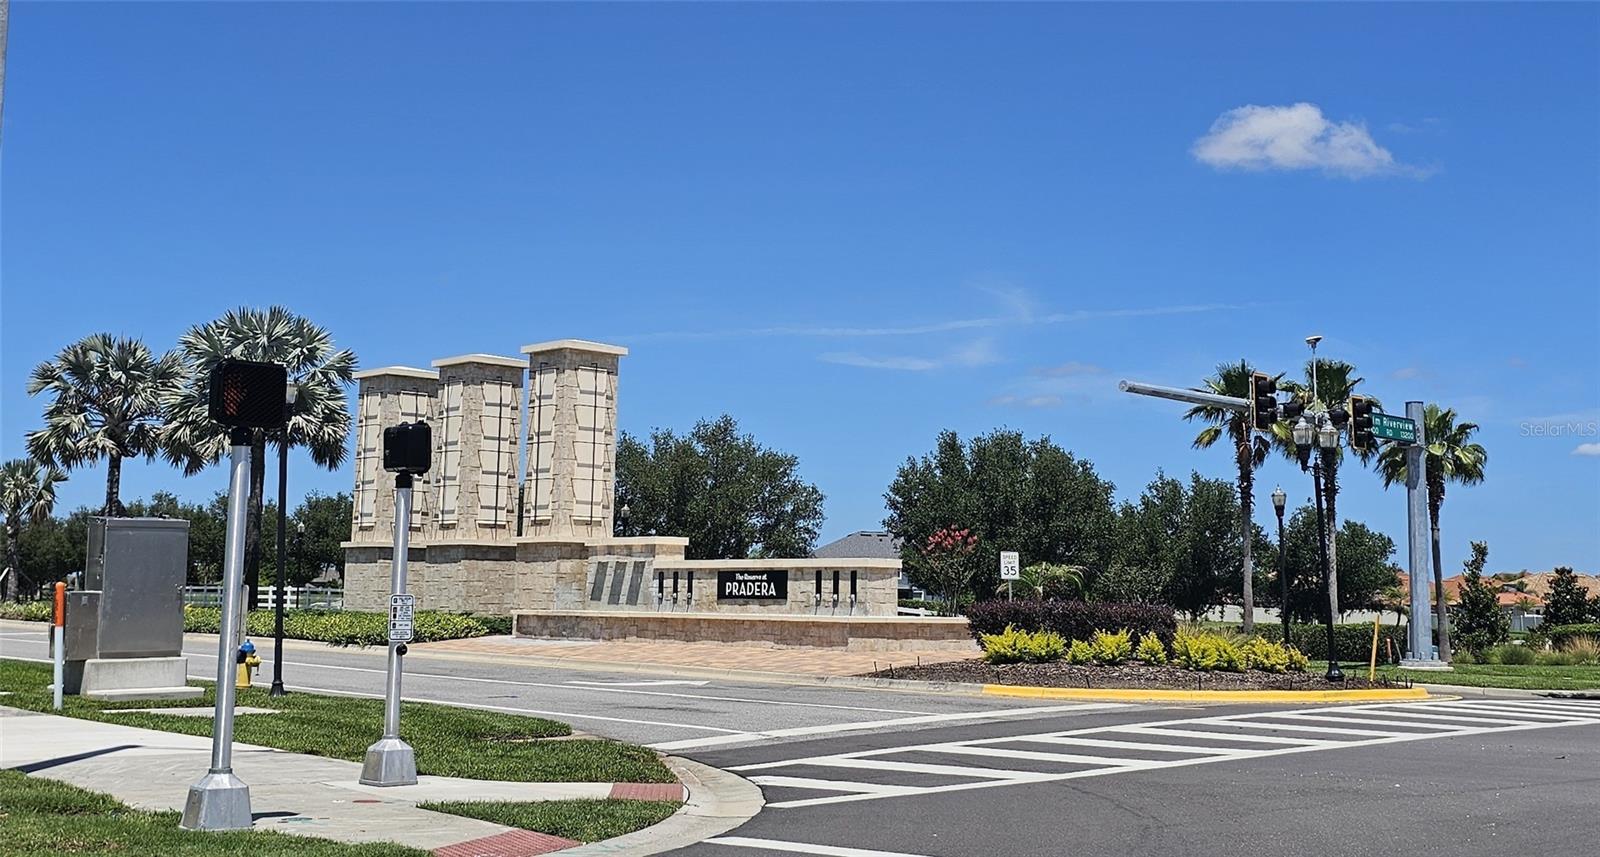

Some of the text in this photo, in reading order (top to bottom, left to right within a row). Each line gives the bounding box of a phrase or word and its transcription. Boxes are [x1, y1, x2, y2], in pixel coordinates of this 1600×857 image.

[1372, 415, 1413, 430] lm Riverview
[1003, 565, 1017, 576] 35
[725, 581, 777, 596] PRADERA
